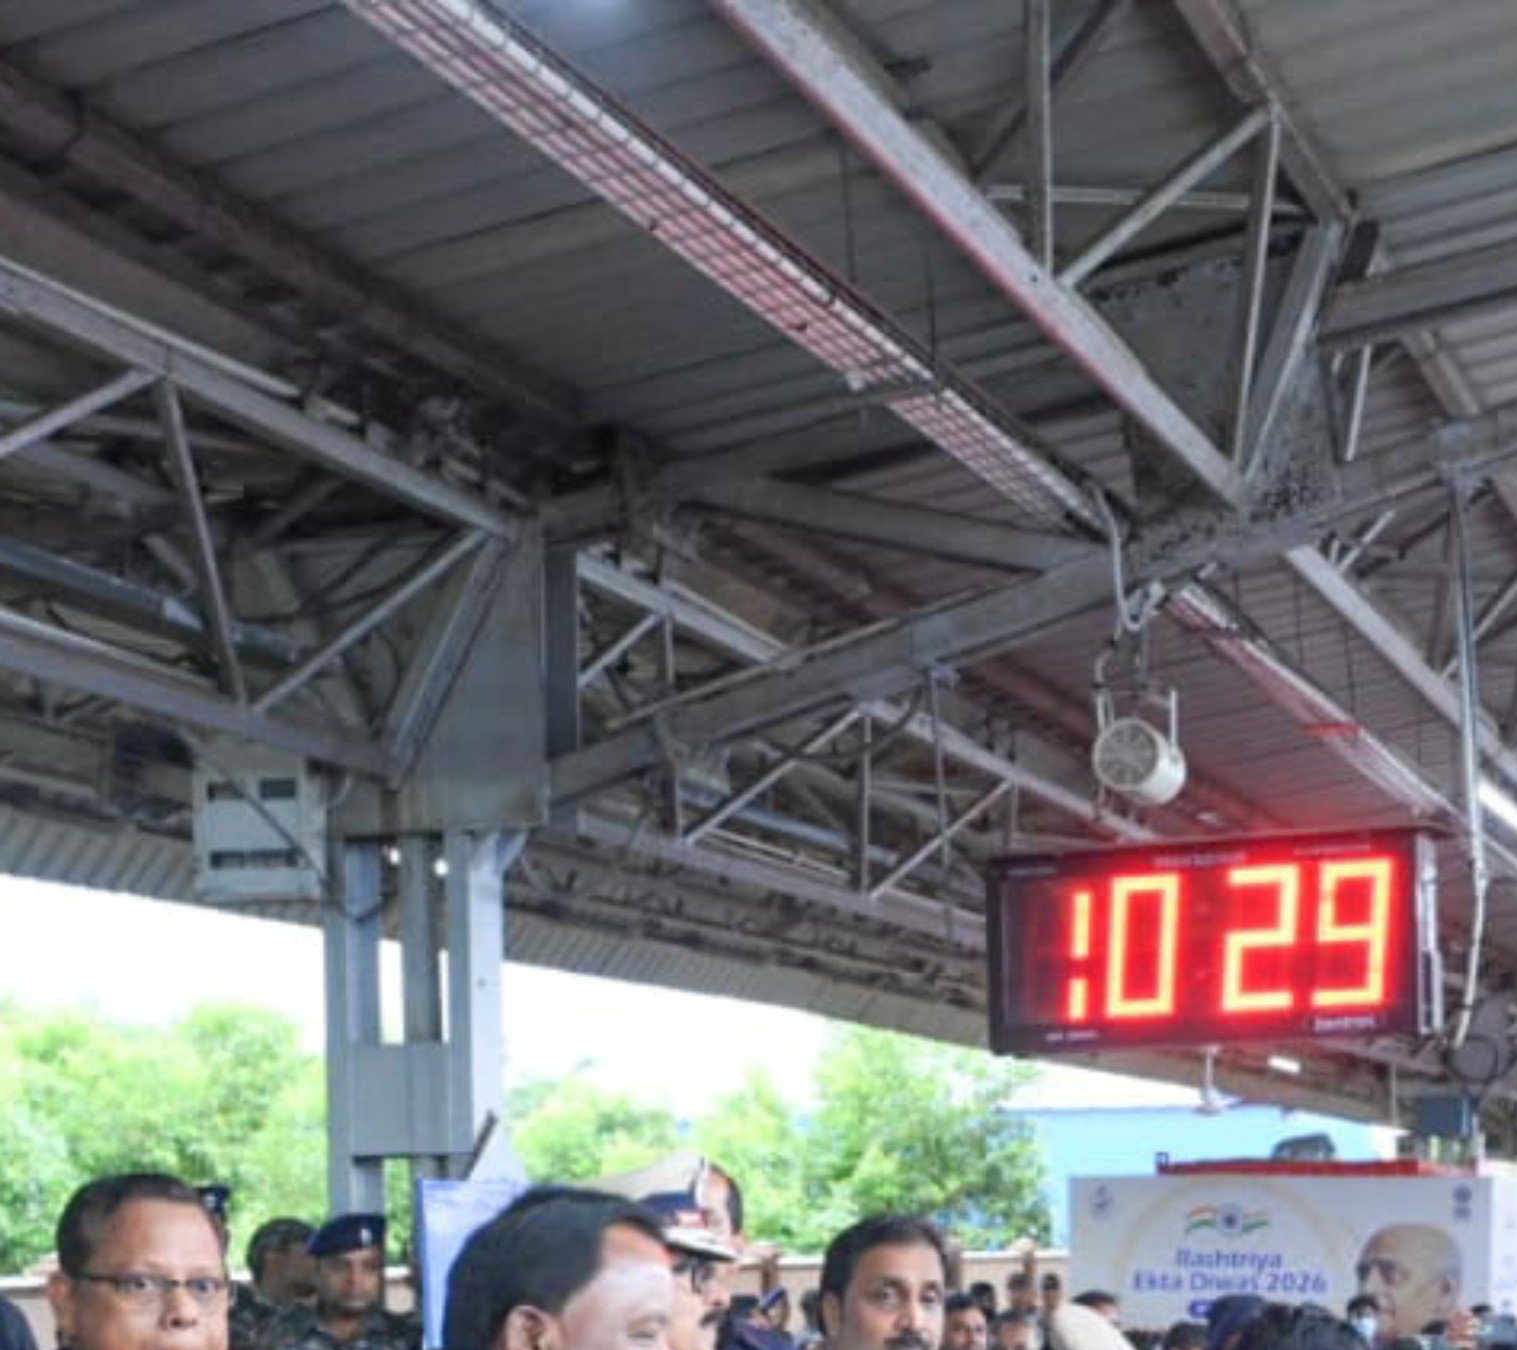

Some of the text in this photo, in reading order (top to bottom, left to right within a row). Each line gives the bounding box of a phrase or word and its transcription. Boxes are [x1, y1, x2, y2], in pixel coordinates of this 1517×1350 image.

[1068, 857, 1393, 1021] 10 29
[1175, 1248, 1283, 1273] Rashtriya
[1133, 1271, 1328, 1293] Ekta Diwas 2026
